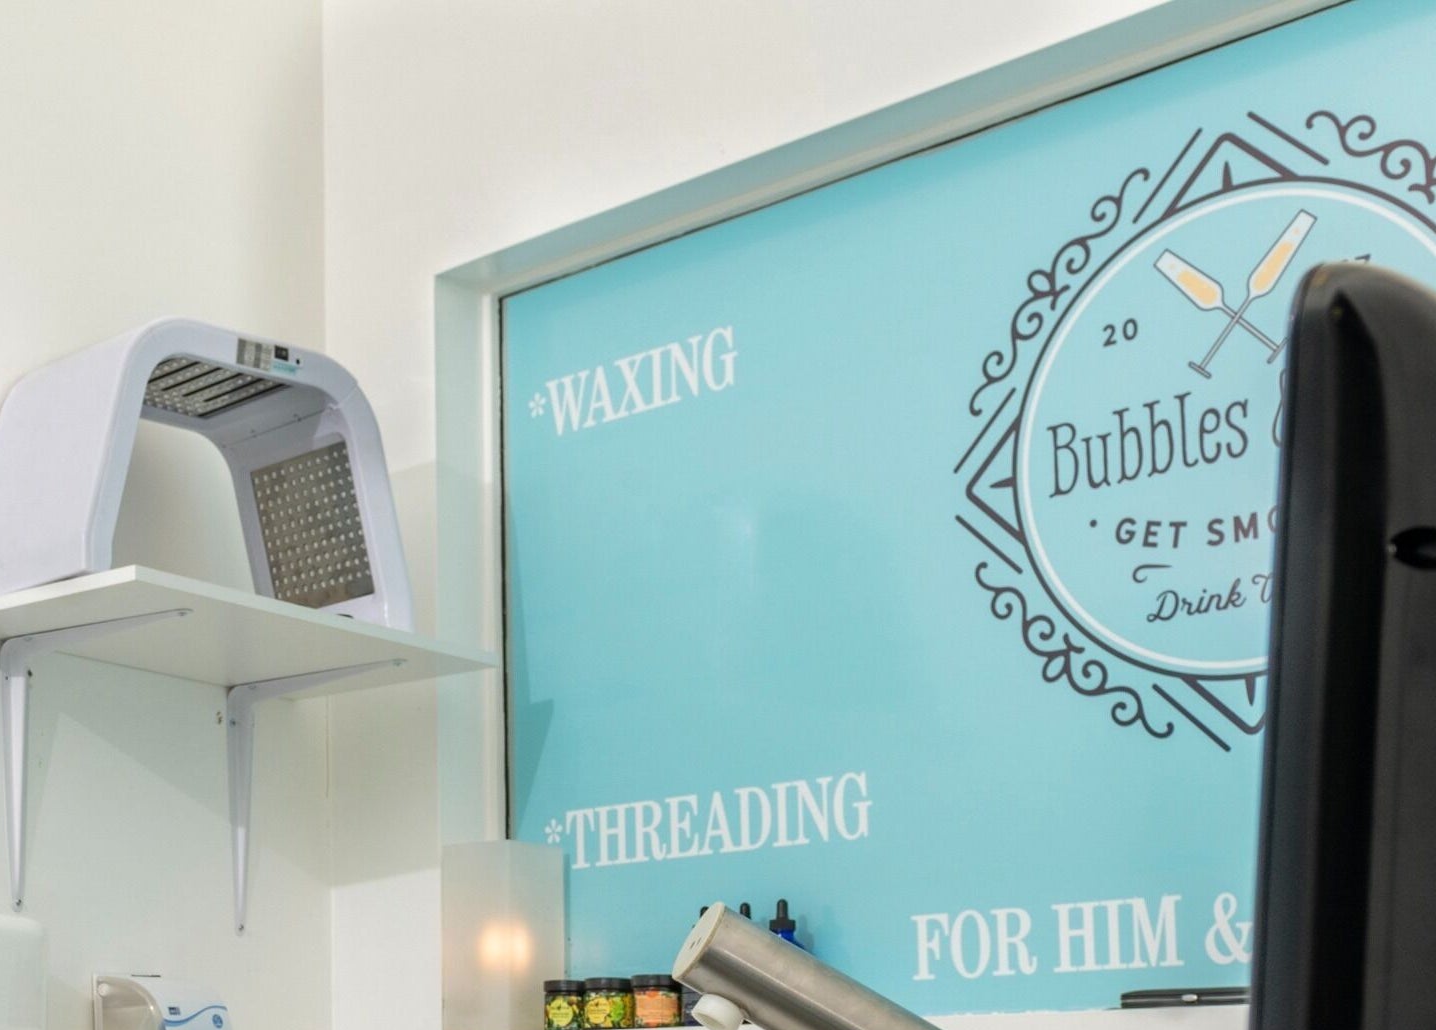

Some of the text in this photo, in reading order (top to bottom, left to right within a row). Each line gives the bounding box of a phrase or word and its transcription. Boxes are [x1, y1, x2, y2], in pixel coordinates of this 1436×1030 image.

[1102, 318, 1138, 347] 20
[1046, 392, 1249, 498] Bubbles
[1115, 517, 1188, 548] GET
[1146, 577, 1247, 622] Drink
[910, 892, 1253, 981] FOR HIM &
